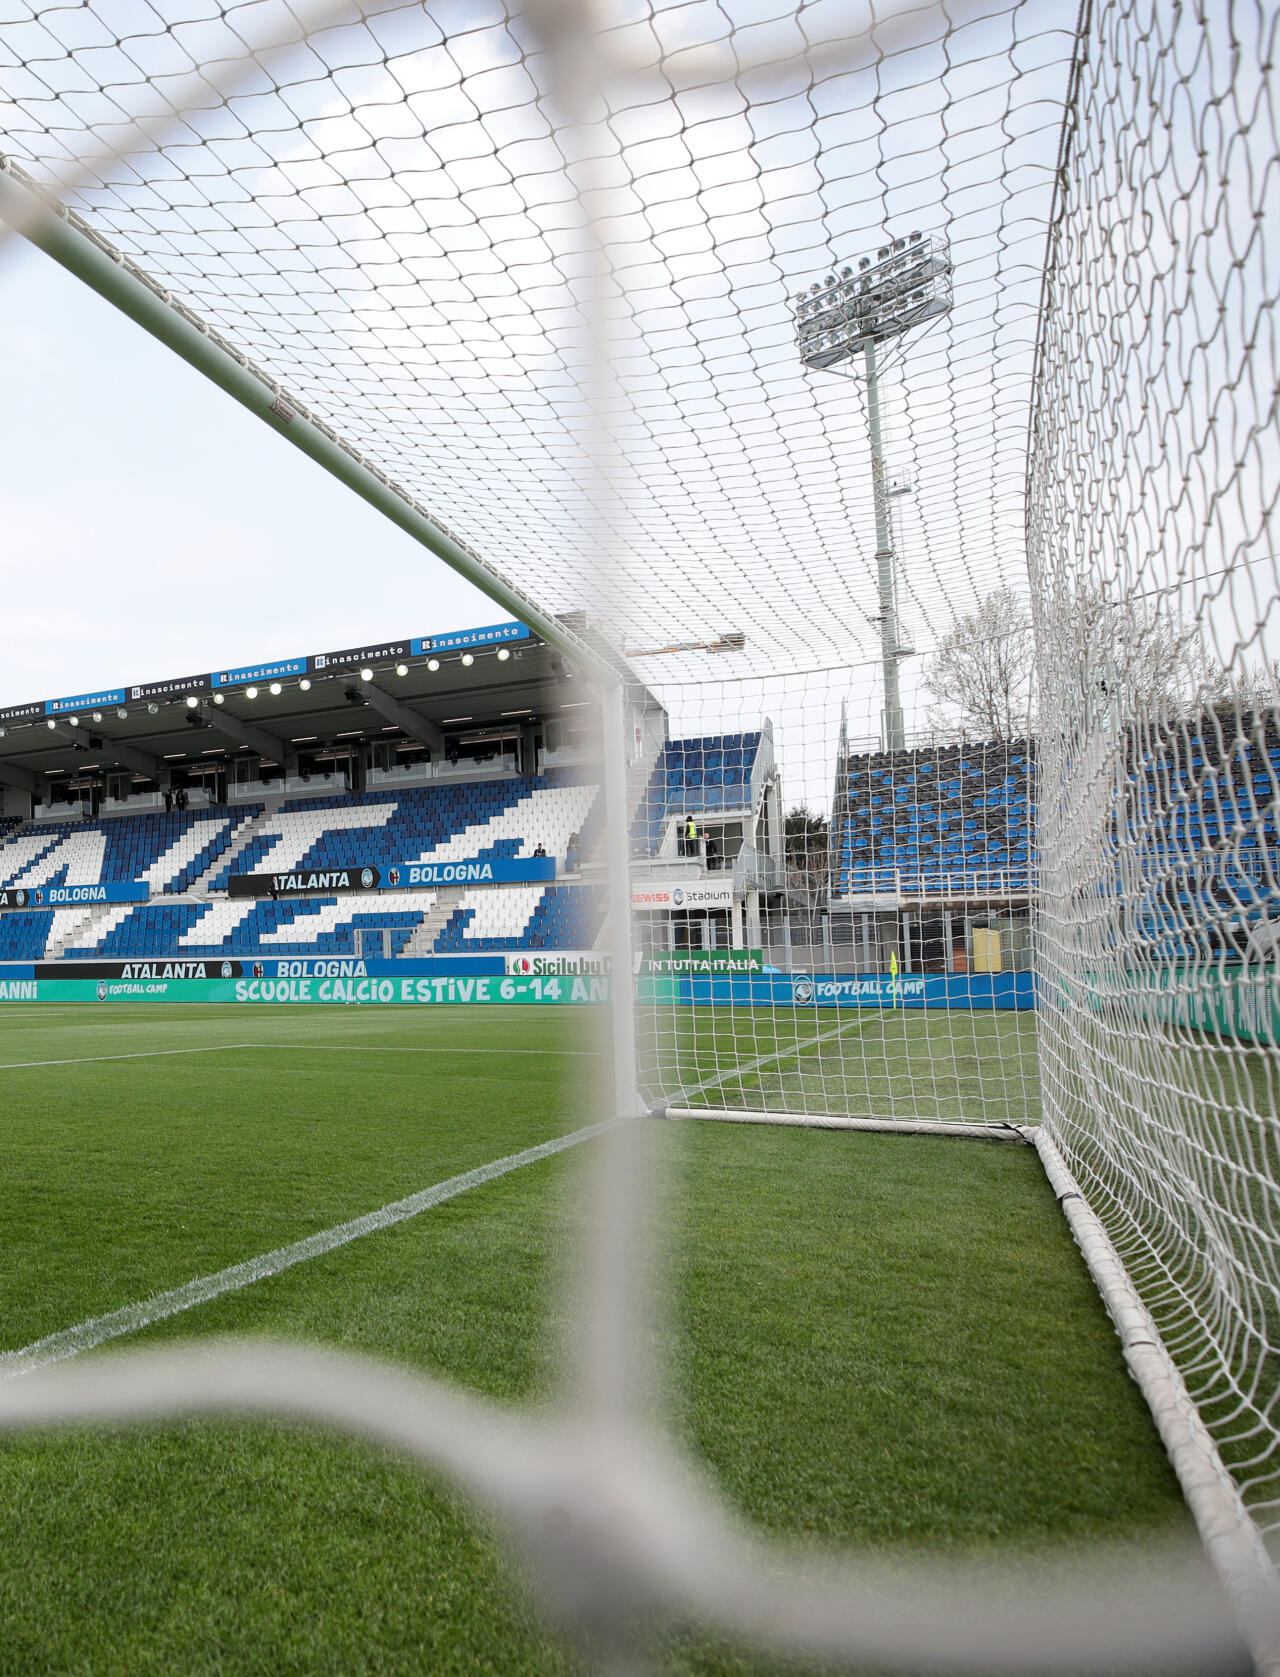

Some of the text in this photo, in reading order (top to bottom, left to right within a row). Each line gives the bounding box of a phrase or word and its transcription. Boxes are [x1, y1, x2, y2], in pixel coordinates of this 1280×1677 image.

[421, 627, 518, 650] Rinascimento
[315, 645, 404, 669] Rinascimento
[220, 662, 299, 684] Rinascimento
[131, 680, 204, 700] Rinascimento
[52, 694, 118, 711] Rinascimento
[409, 863, 493, 883] BOLOGNA
[49, 886, 107, 902] BOLOGNA
[687, 891, 730, 901] Stadium
[121, 960, 368, 979] ATALANTA BOLOGNA
[648, 959, 760, 972] IN TUTTA ITALIA
[109, 983, 168, 995] FOOTBALL CAMP
[235, 981, 312, 1001] SCUOLE
[500, 978, 562, 1001] 6-14
[817, 981, 925, 997] FOOTBALL CAMP
